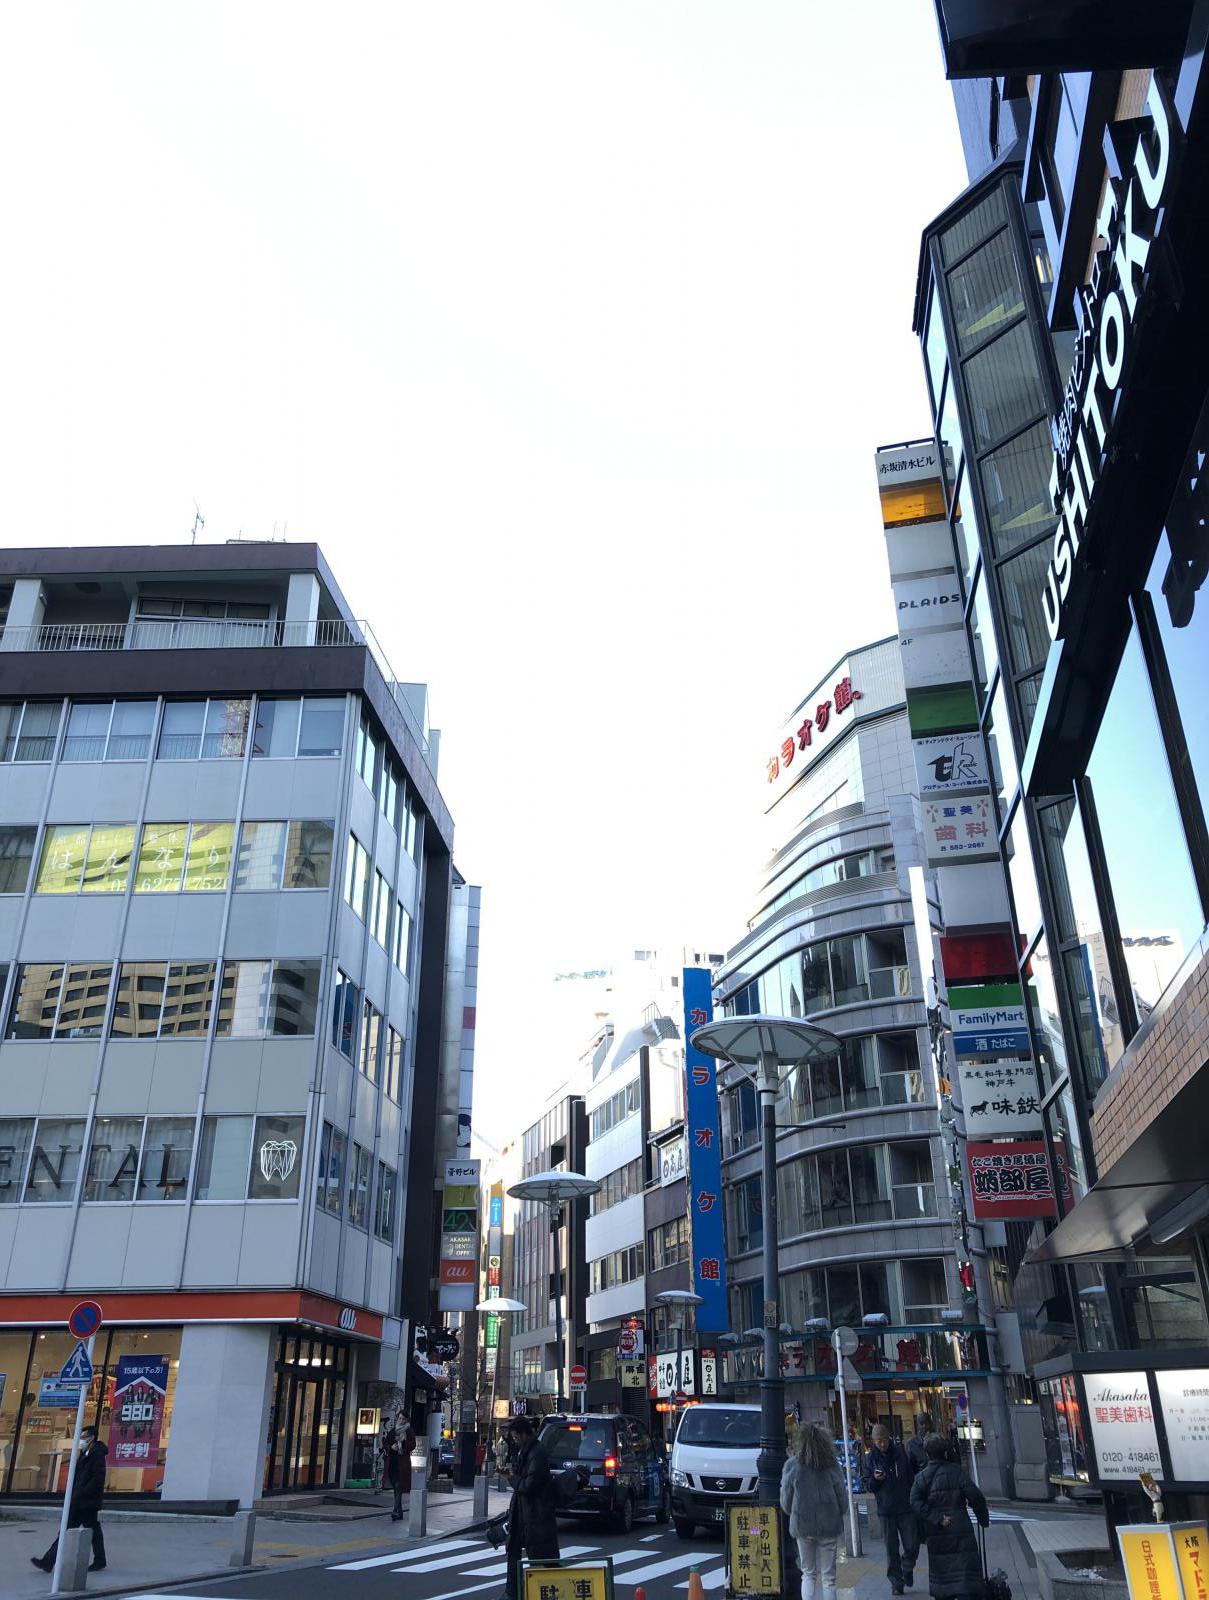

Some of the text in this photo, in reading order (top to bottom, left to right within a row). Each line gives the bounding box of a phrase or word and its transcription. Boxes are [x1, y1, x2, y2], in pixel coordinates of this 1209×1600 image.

[1042, 72, 1170, 641] USHITOKU
[880, 456, 936, 474] 赤坂清水ビル
[899, 594, 962, 610] PLAIDS
[767, 677, 852, 783] カラオケ館
[934, 821, 988, 842] 歯科
[958, 1011, 1025, 1025] FamilyMart
[975, 1038, 1016, 1051] 酒 たばこ
[964, 1067, 1034, 1079] 黒毛和牛専門店
[985, 1079, 1016, 1088] 神戸牛
[991, 1096, 1040, 1115] 味鉄
[690, 1008, 720, 1280] カラオケ館
[446, 1265, 470, 1278] au
[121, 1404, 153, 1421] 980
[1095, 1406, 1152, 1424] 聖美歯科
[1102, 1452, 1159, 1462] 0120 418461
[736, 1511, 751, 1589] 駐車禁止
[758, 1512, 772, 1588] 車の出入口
